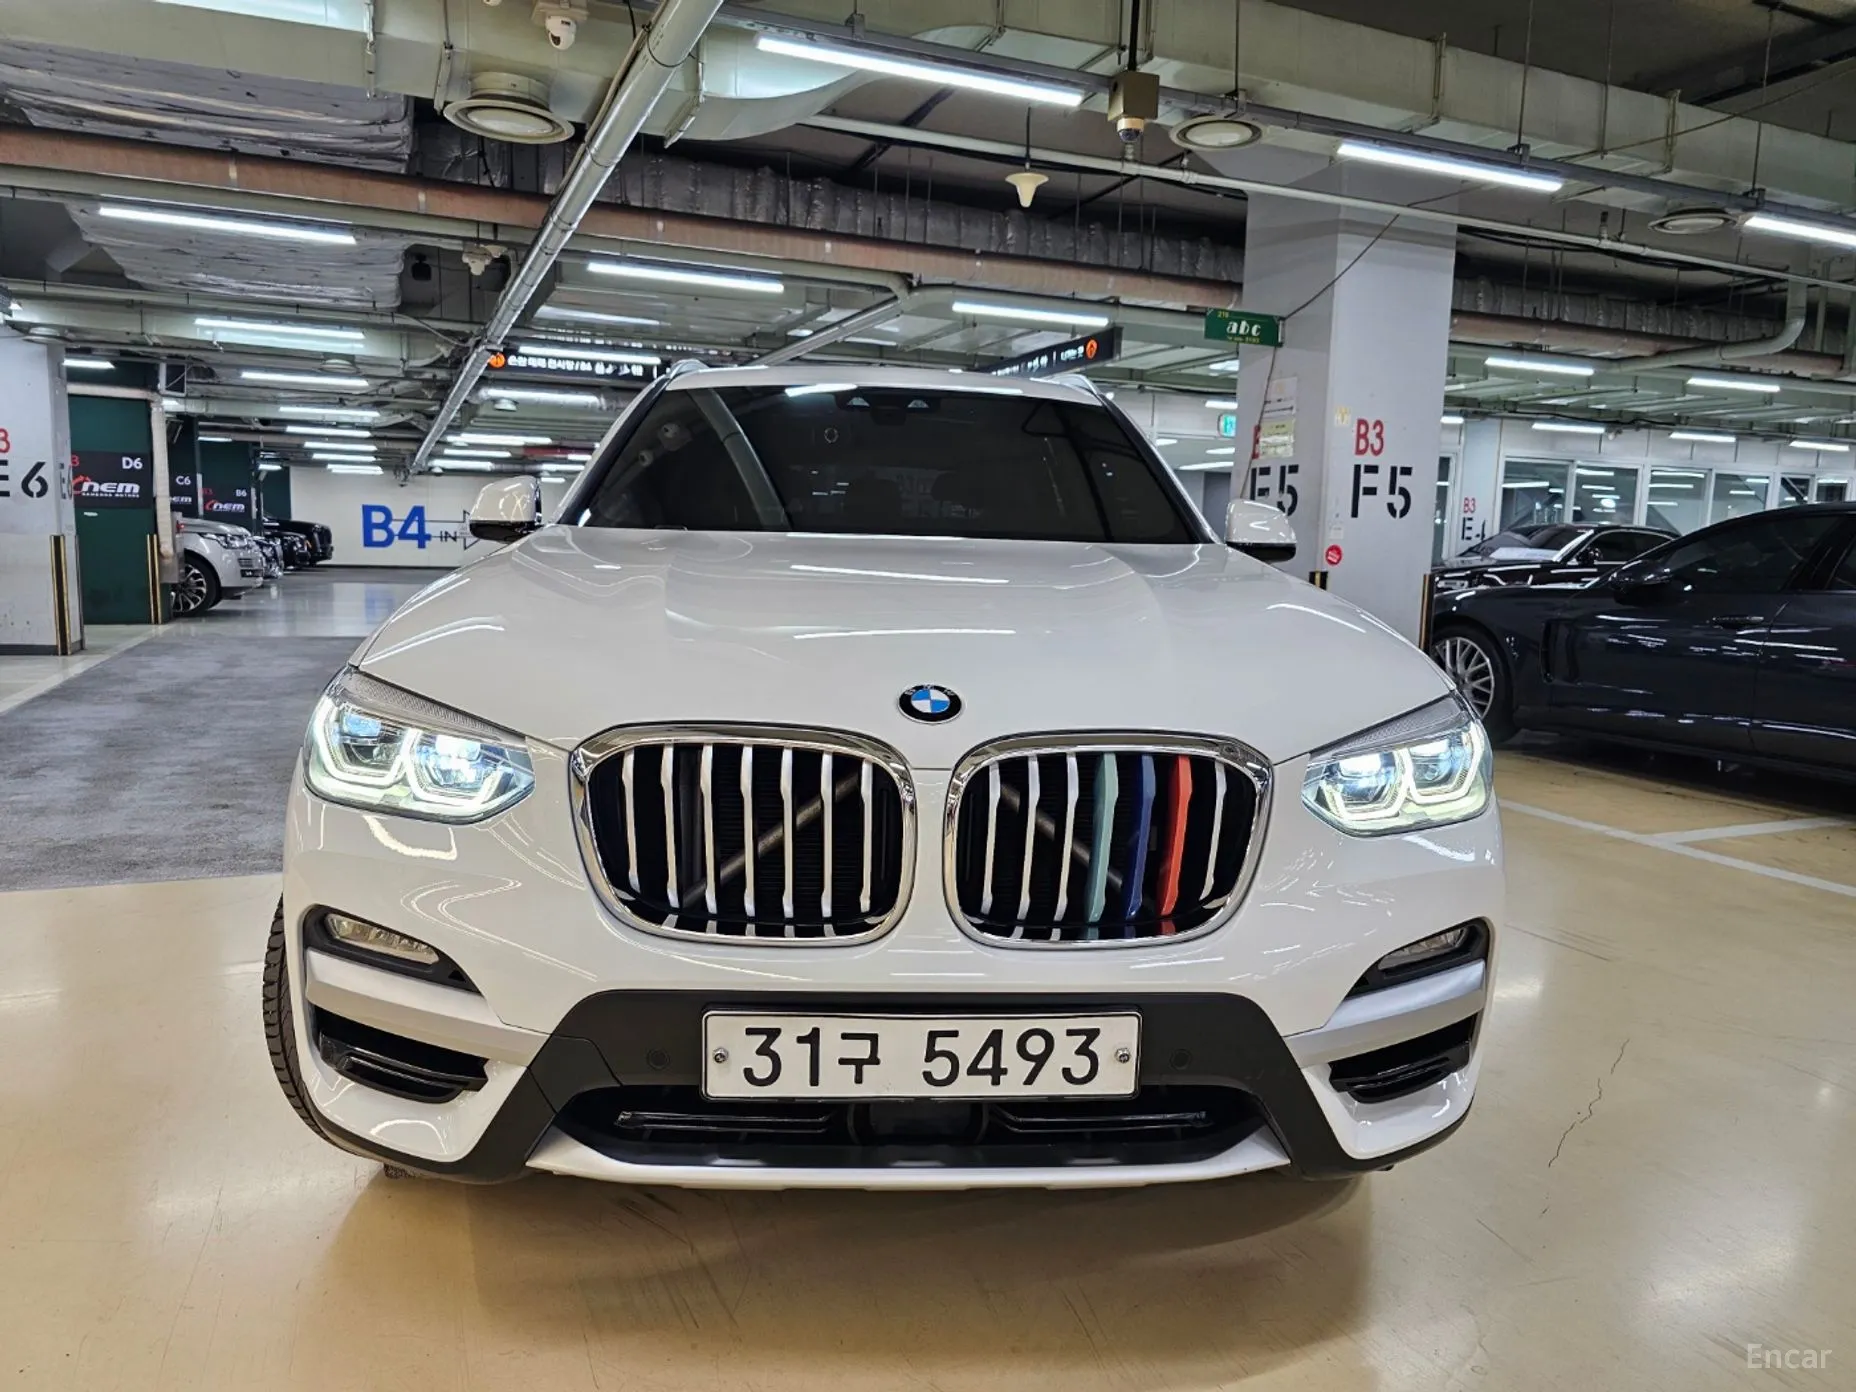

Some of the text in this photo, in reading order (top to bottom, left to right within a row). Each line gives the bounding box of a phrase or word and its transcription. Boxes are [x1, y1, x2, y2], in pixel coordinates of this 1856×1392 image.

[1226, 320, 1262, 336] abc
[1354, 418, 1385, 456] B3
[122, 457, 143, 469] D6
[175, 475, 192, 486] C6
[236, 489, 247, 497] B6
[1351, 464, 1413, 518] F5
[1463, 497, 1476, 513] B3
[361, 504, 431, 549] B4
[440, 531, 457, 542] IN
[742, 1027, 1101, 1087] 31구 5493
